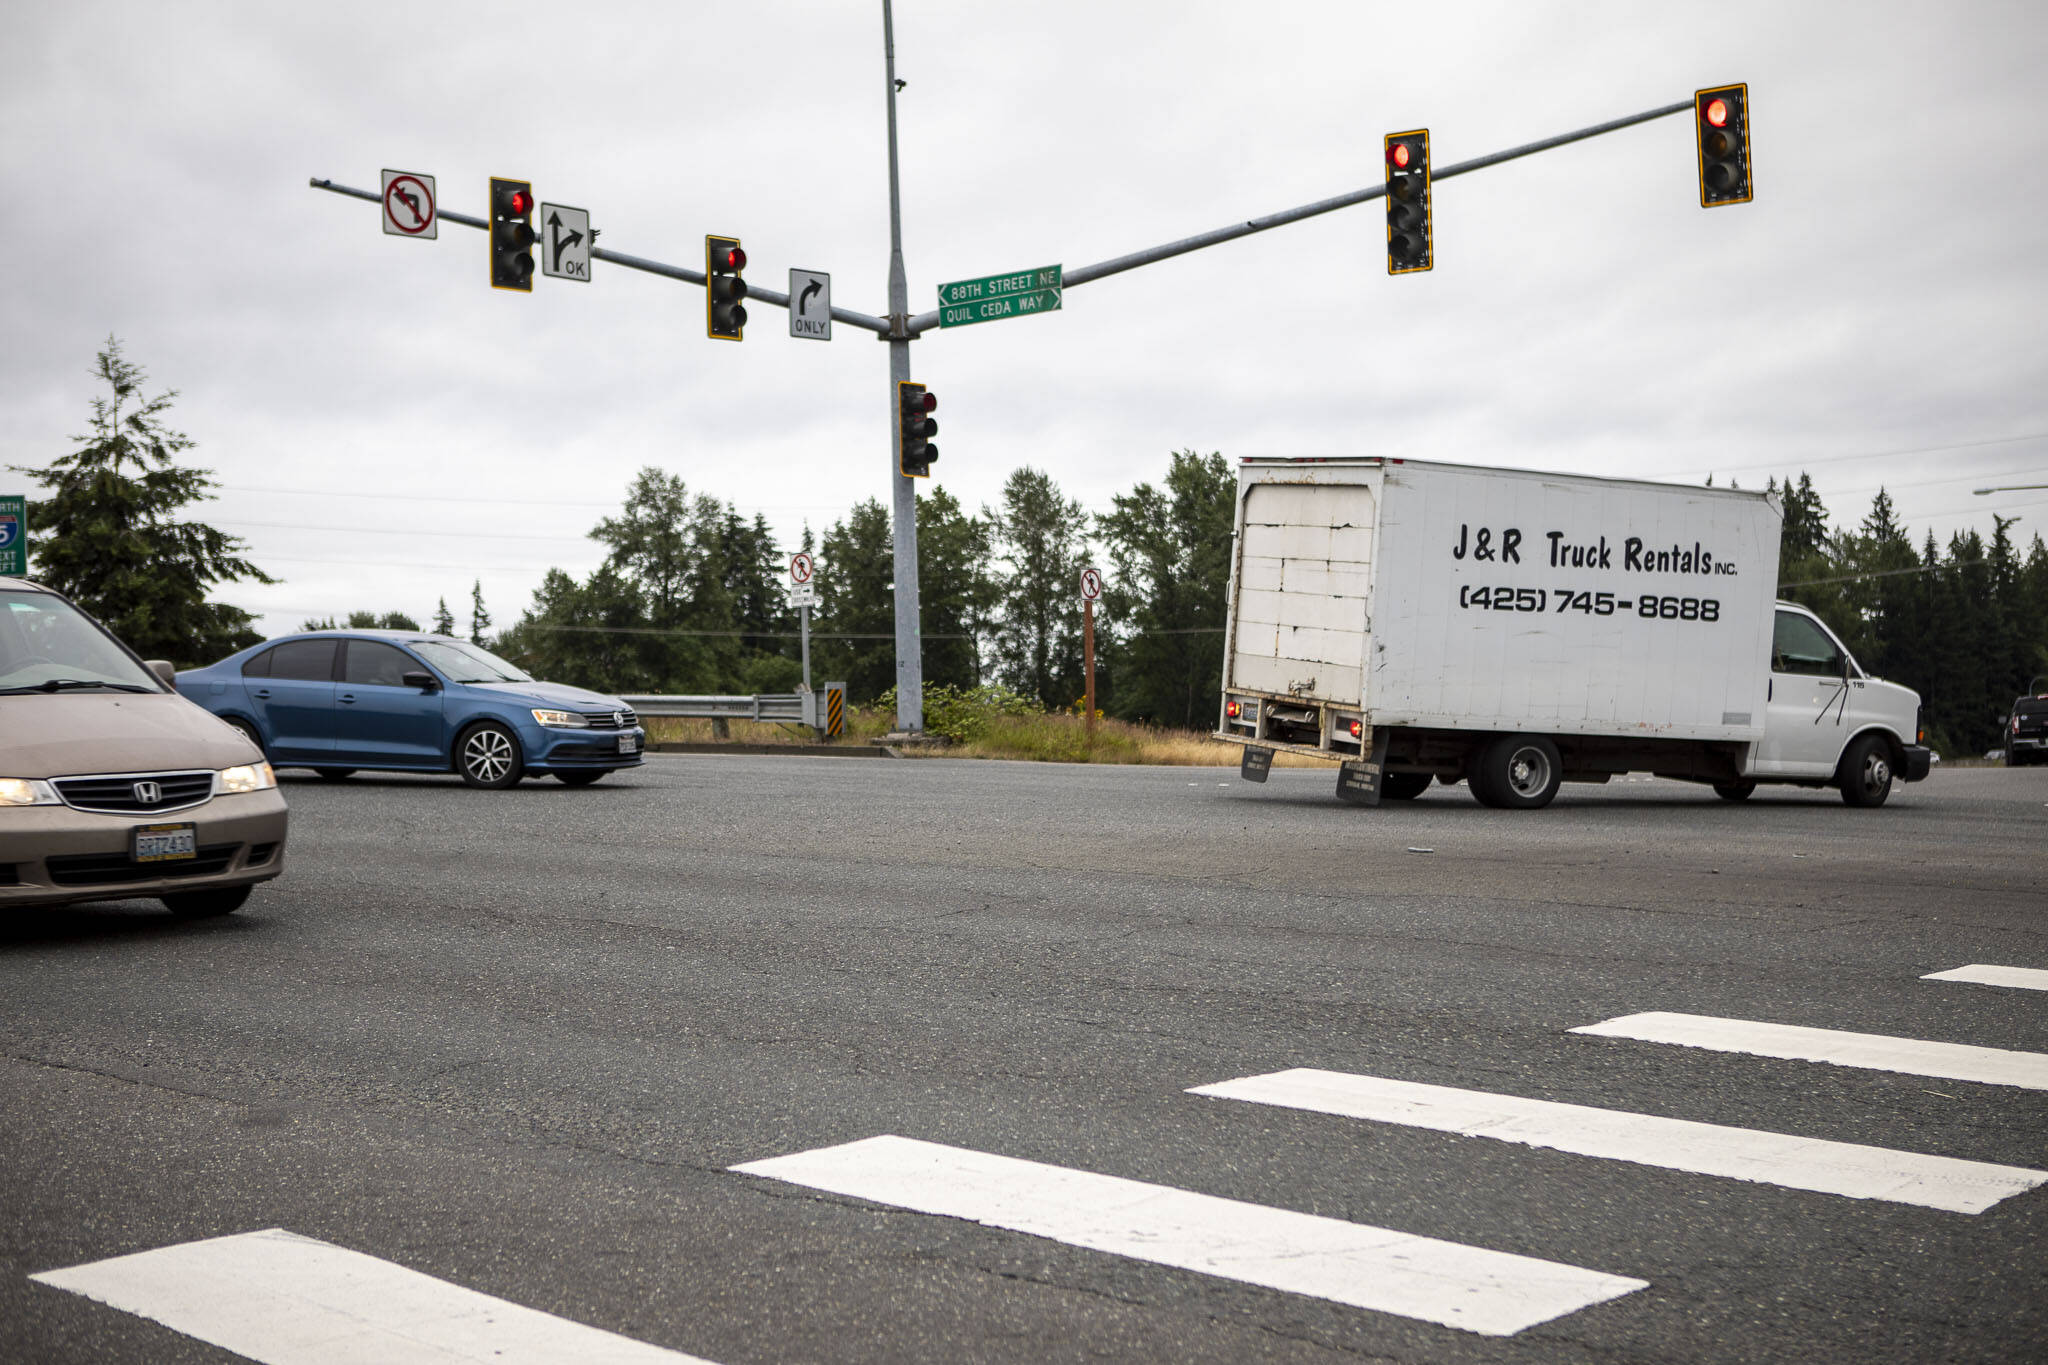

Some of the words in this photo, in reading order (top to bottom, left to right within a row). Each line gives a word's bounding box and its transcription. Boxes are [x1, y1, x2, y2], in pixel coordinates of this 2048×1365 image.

[565, 261, 585, 276] OK
[951, 283, 982, 300] 88TH
[988, 275, 1033, 294] STREET
[1039, 271, 1056, 285] NE
[946, 308, 974, 323] QUIL
[980, 301, 1012, 317] CEDA
[1018, 295, 1044, 310] WAY
[795, 319, 826, 334] ONLY
[0, 503, 20, 513] RTH
[1546, 530, 1611, 570] Truck
[1624, 536, 1712, 575] Rentals
[1714, 562, 1738, 576] INC.
[1460, 585, 1547, 612] (425)
[1554, 589, 1721, 623] 745-8688
